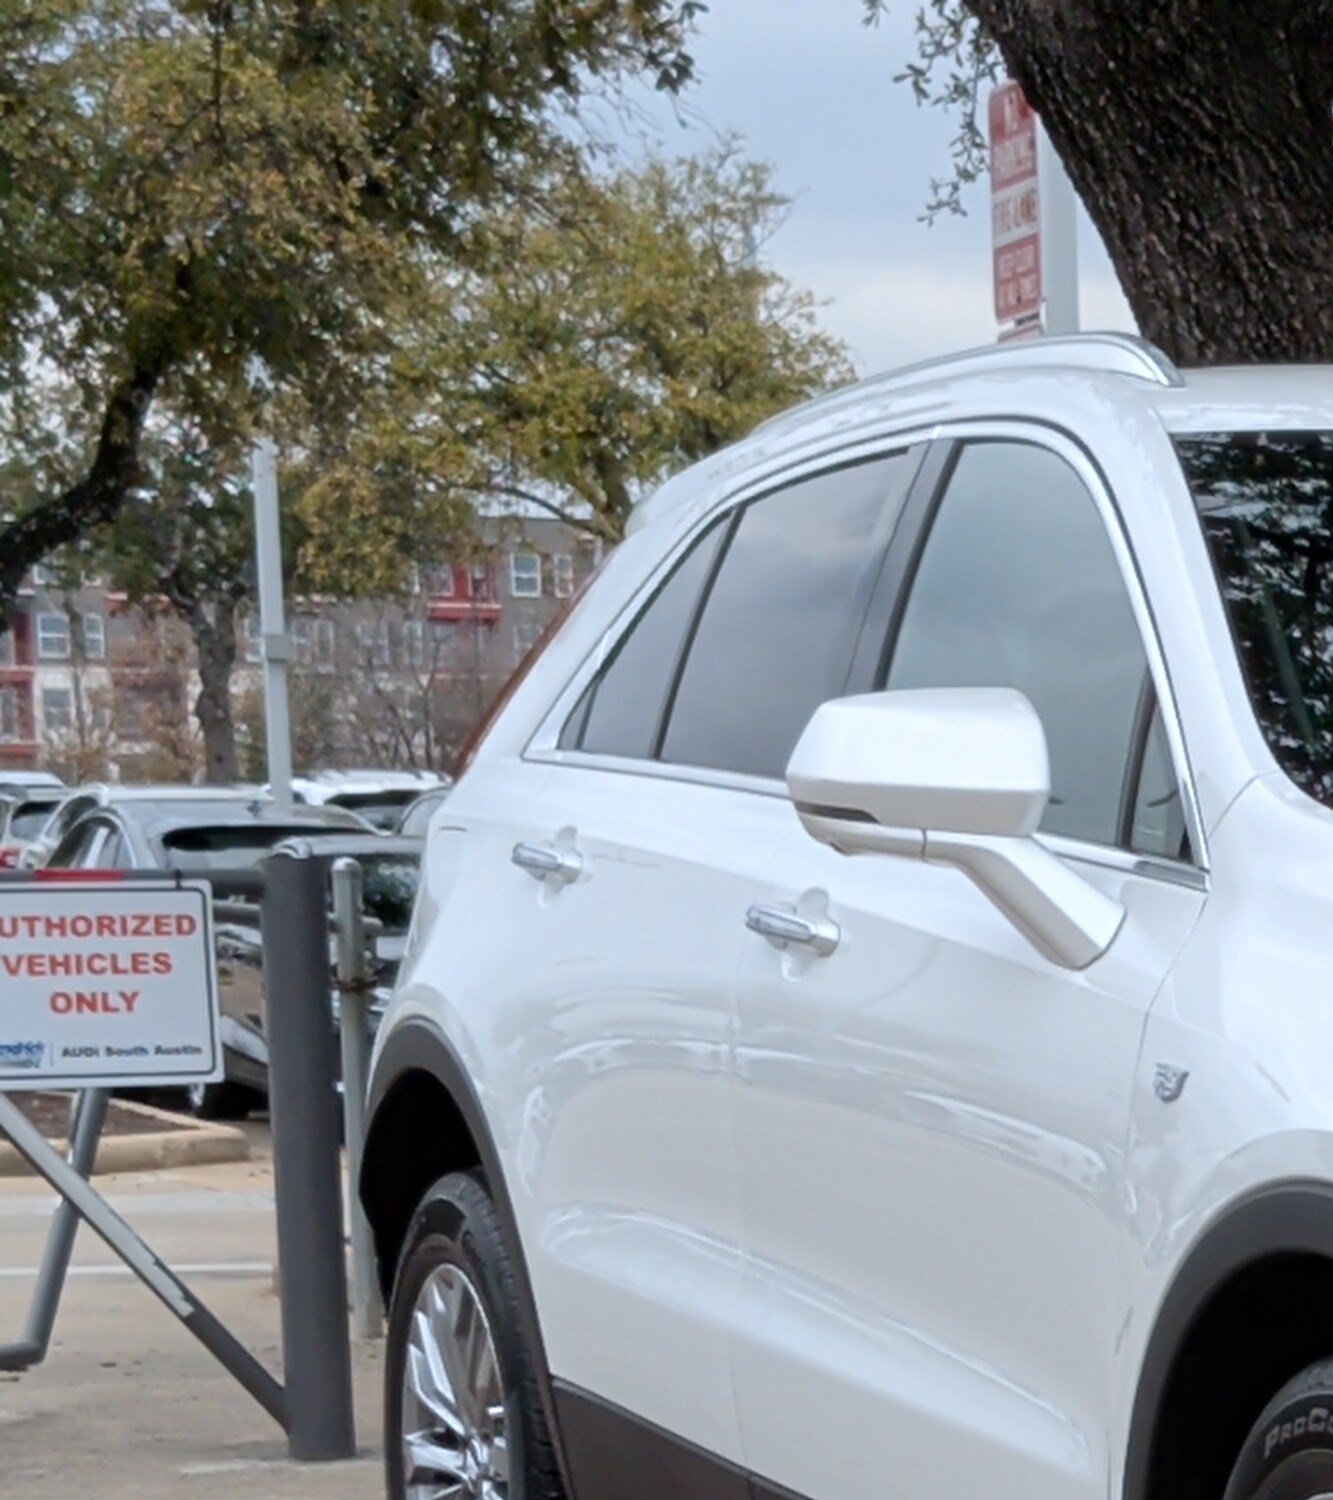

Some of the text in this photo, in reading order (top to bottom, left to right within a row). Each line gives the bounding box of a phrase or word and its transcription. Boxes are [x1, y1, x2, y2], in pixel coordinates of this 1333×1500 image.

[0, 914, 197, 938] UTHORIZED
[1, 952, 173, 977] VEHICLES
[49, 990, 140, 1014] ONLY
[104, 1045, 149, 1058] South
[154, 1044, 202, 1056] Austin
